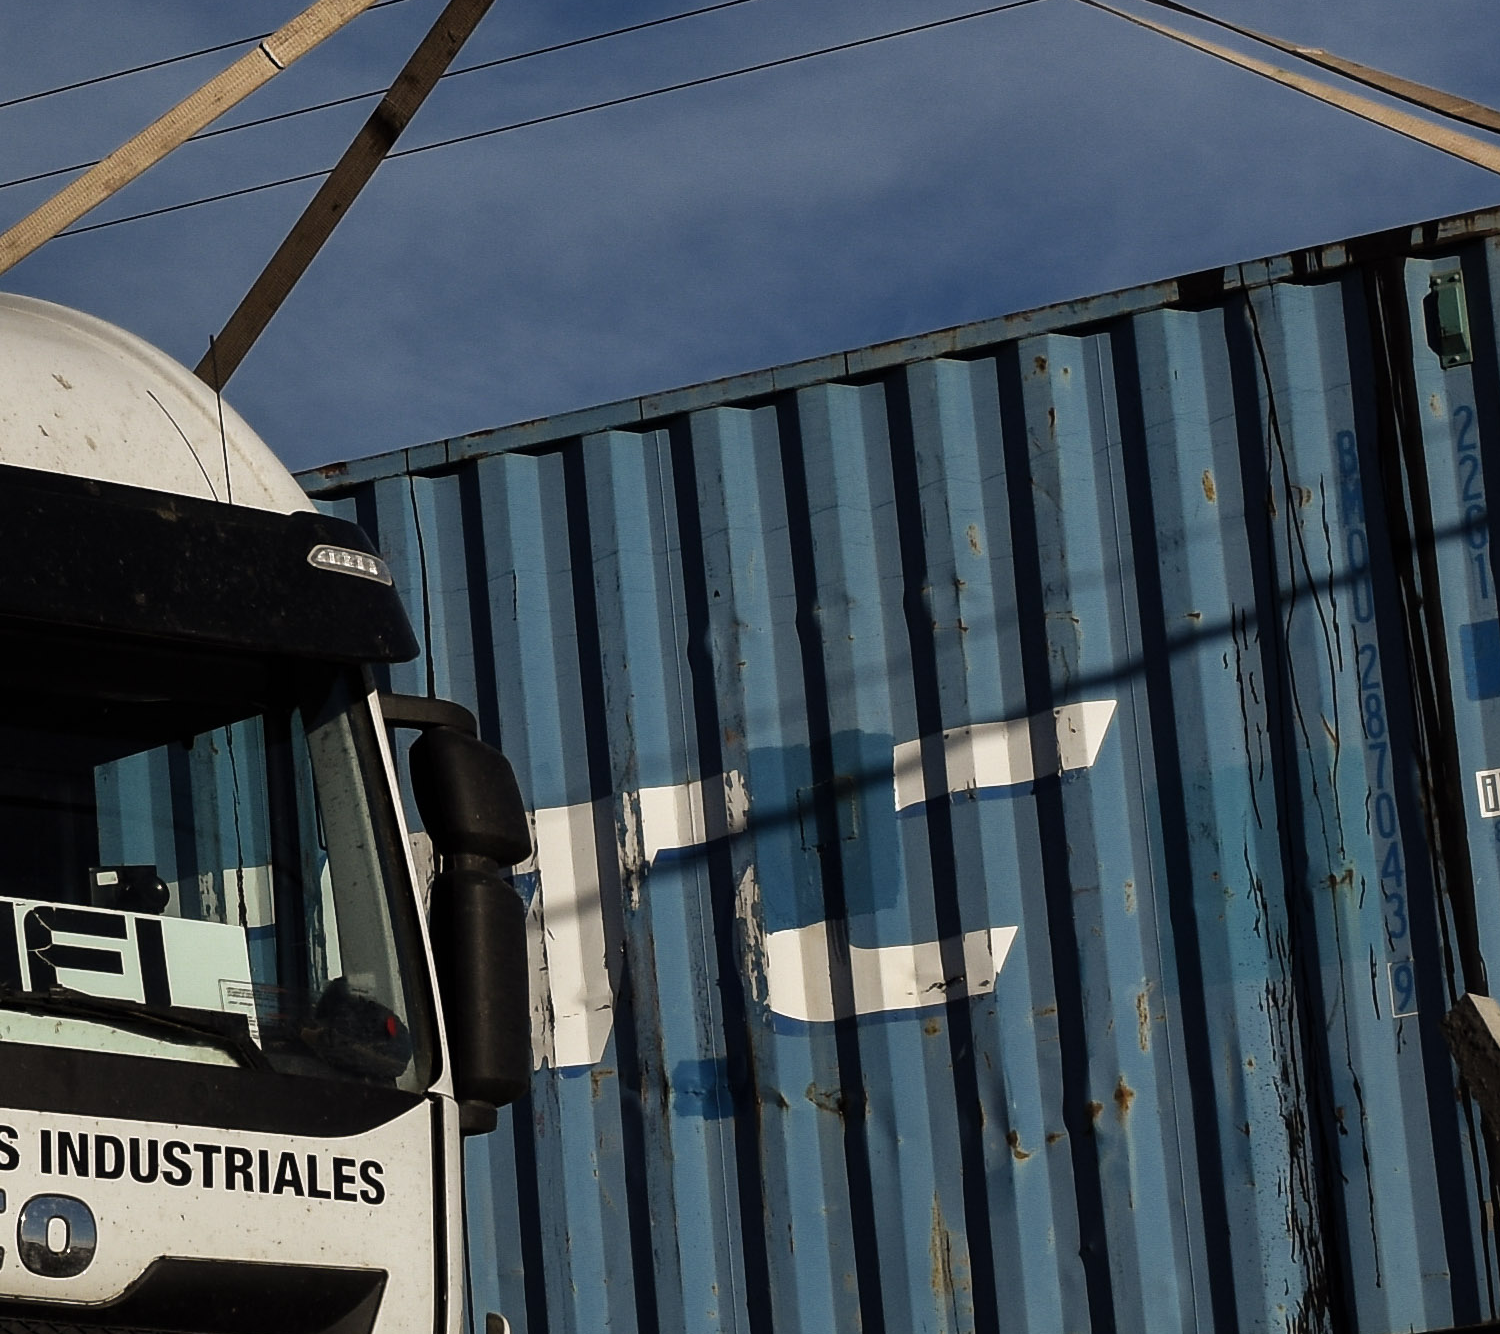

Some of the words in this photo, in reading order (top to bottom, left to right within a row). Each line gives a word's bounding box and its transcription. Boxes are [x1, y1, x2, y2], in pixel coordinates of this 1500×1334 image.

[1359, 643, 1407, 940] 287043
[1393, 965, 1414, 1012] 9
[40, 1131, 386, 1206] INDUSTRIALES
